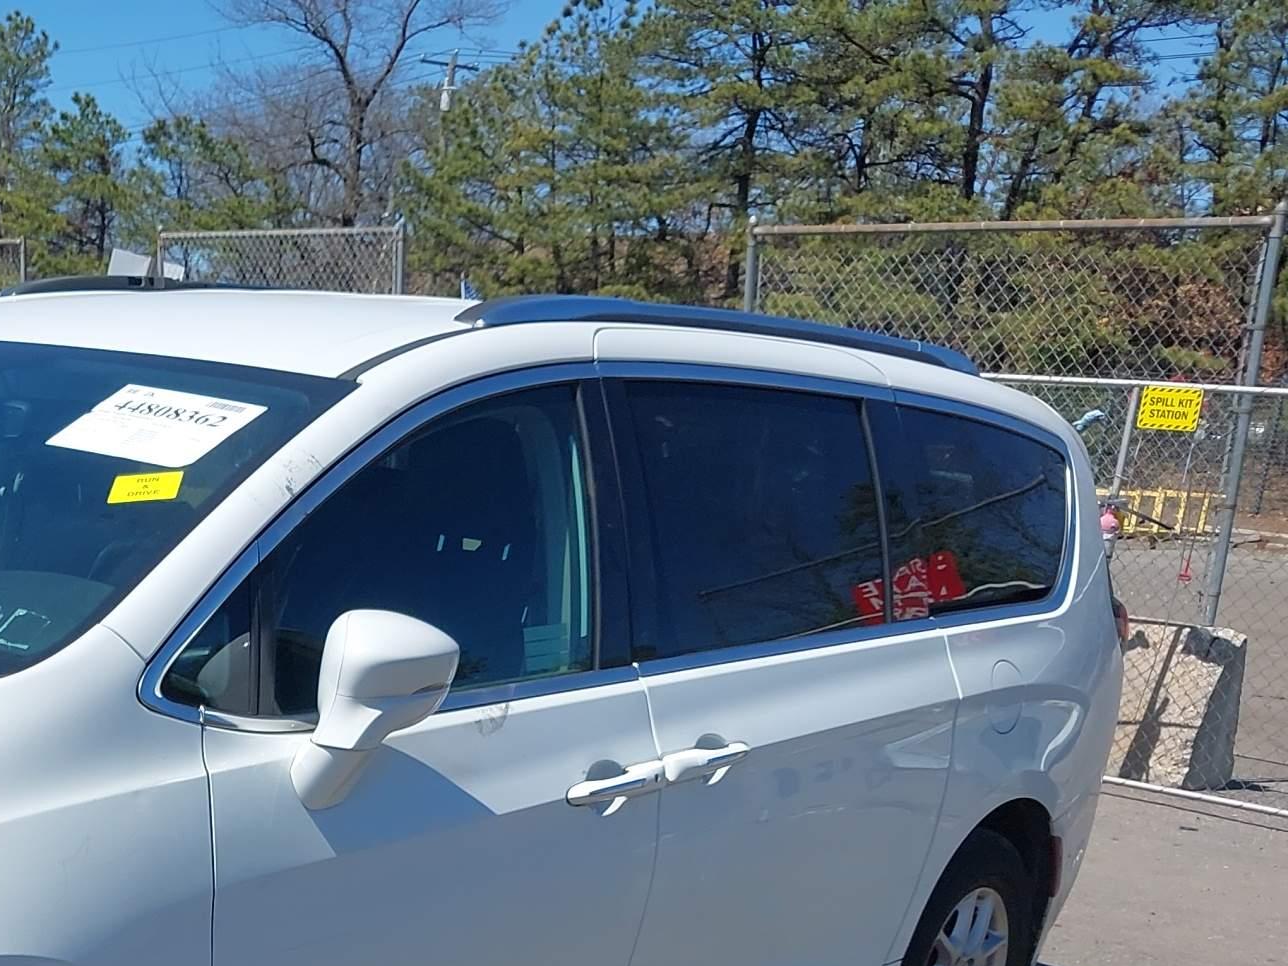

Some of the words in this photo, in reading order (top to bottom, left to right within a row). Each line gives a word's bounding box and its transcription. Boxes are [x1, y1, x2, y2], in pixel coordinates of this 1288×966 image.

[1148, 396, 1176, 408] SPILL
[1178, 398, 1194, 408] KIT
[114, 400, 228, 428] 44808362
[1148, 409, 1189, 420] STATION
